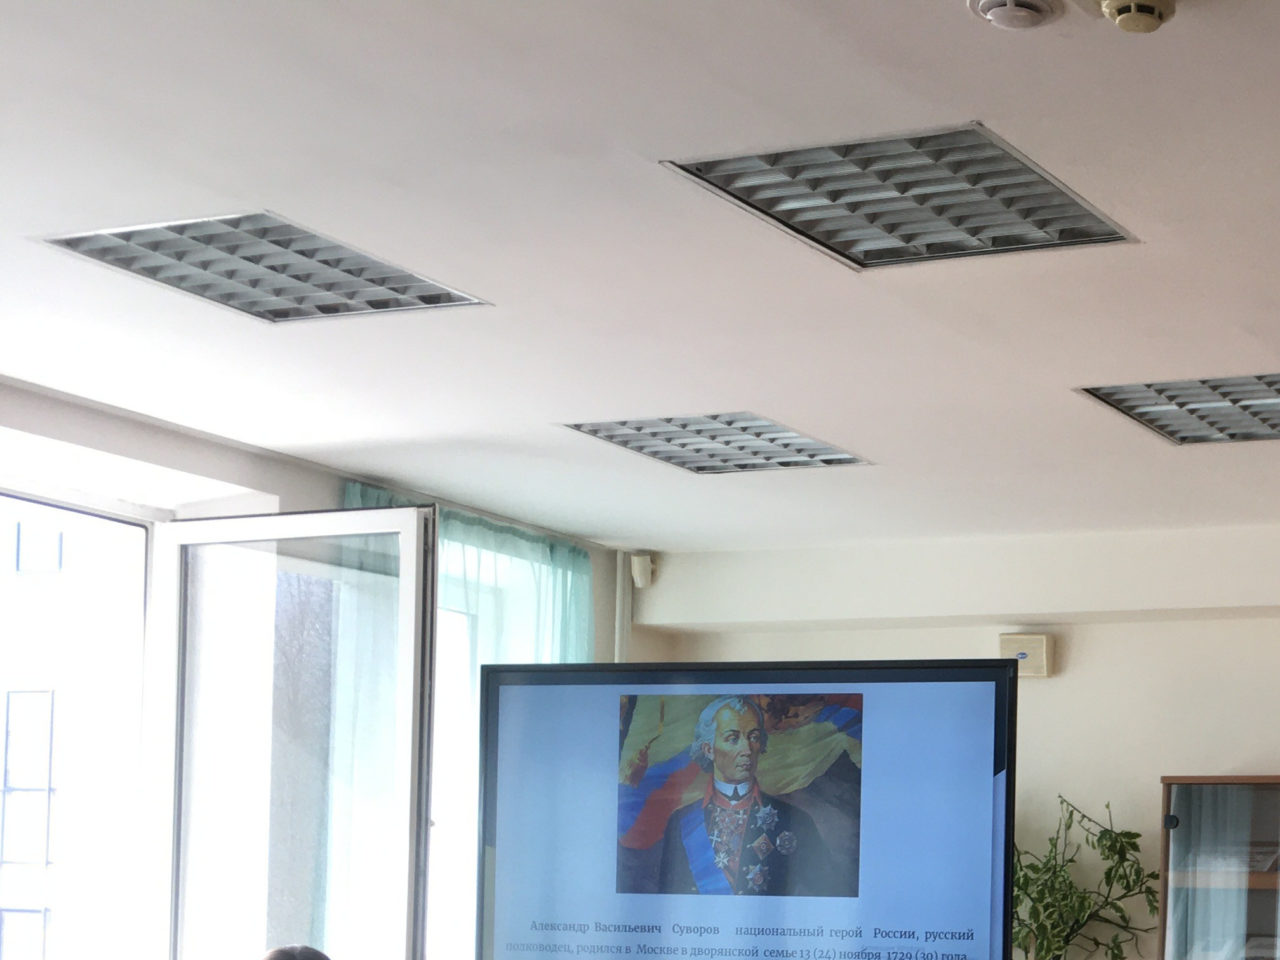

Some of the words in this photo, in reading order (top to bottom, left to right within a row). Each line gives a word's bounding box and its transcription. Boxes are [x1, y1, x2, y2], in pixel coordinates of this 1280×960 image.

[530, 920, 590, 934] Александр
[594, 921, 662, 935] Васильевич
[672, 923, 720, 937] Суворов
[735, 925, 824, 938] национальный
[829, 926, 863, 940] герой
[873, 927, 919, 941] России,
[924, 928, 975, 942] русский
[576, 943, 623, 956] родился
[625, 945, 632, 954] в
[636, 944, 678, 956] Москве
[681, 947, 688, 956] в
[690, 946, 759, 959] дворянской
[763, 948, 797, 958] семье
[799, 949, 811, 960] 13
[813, 948, 836, 960] (24)
